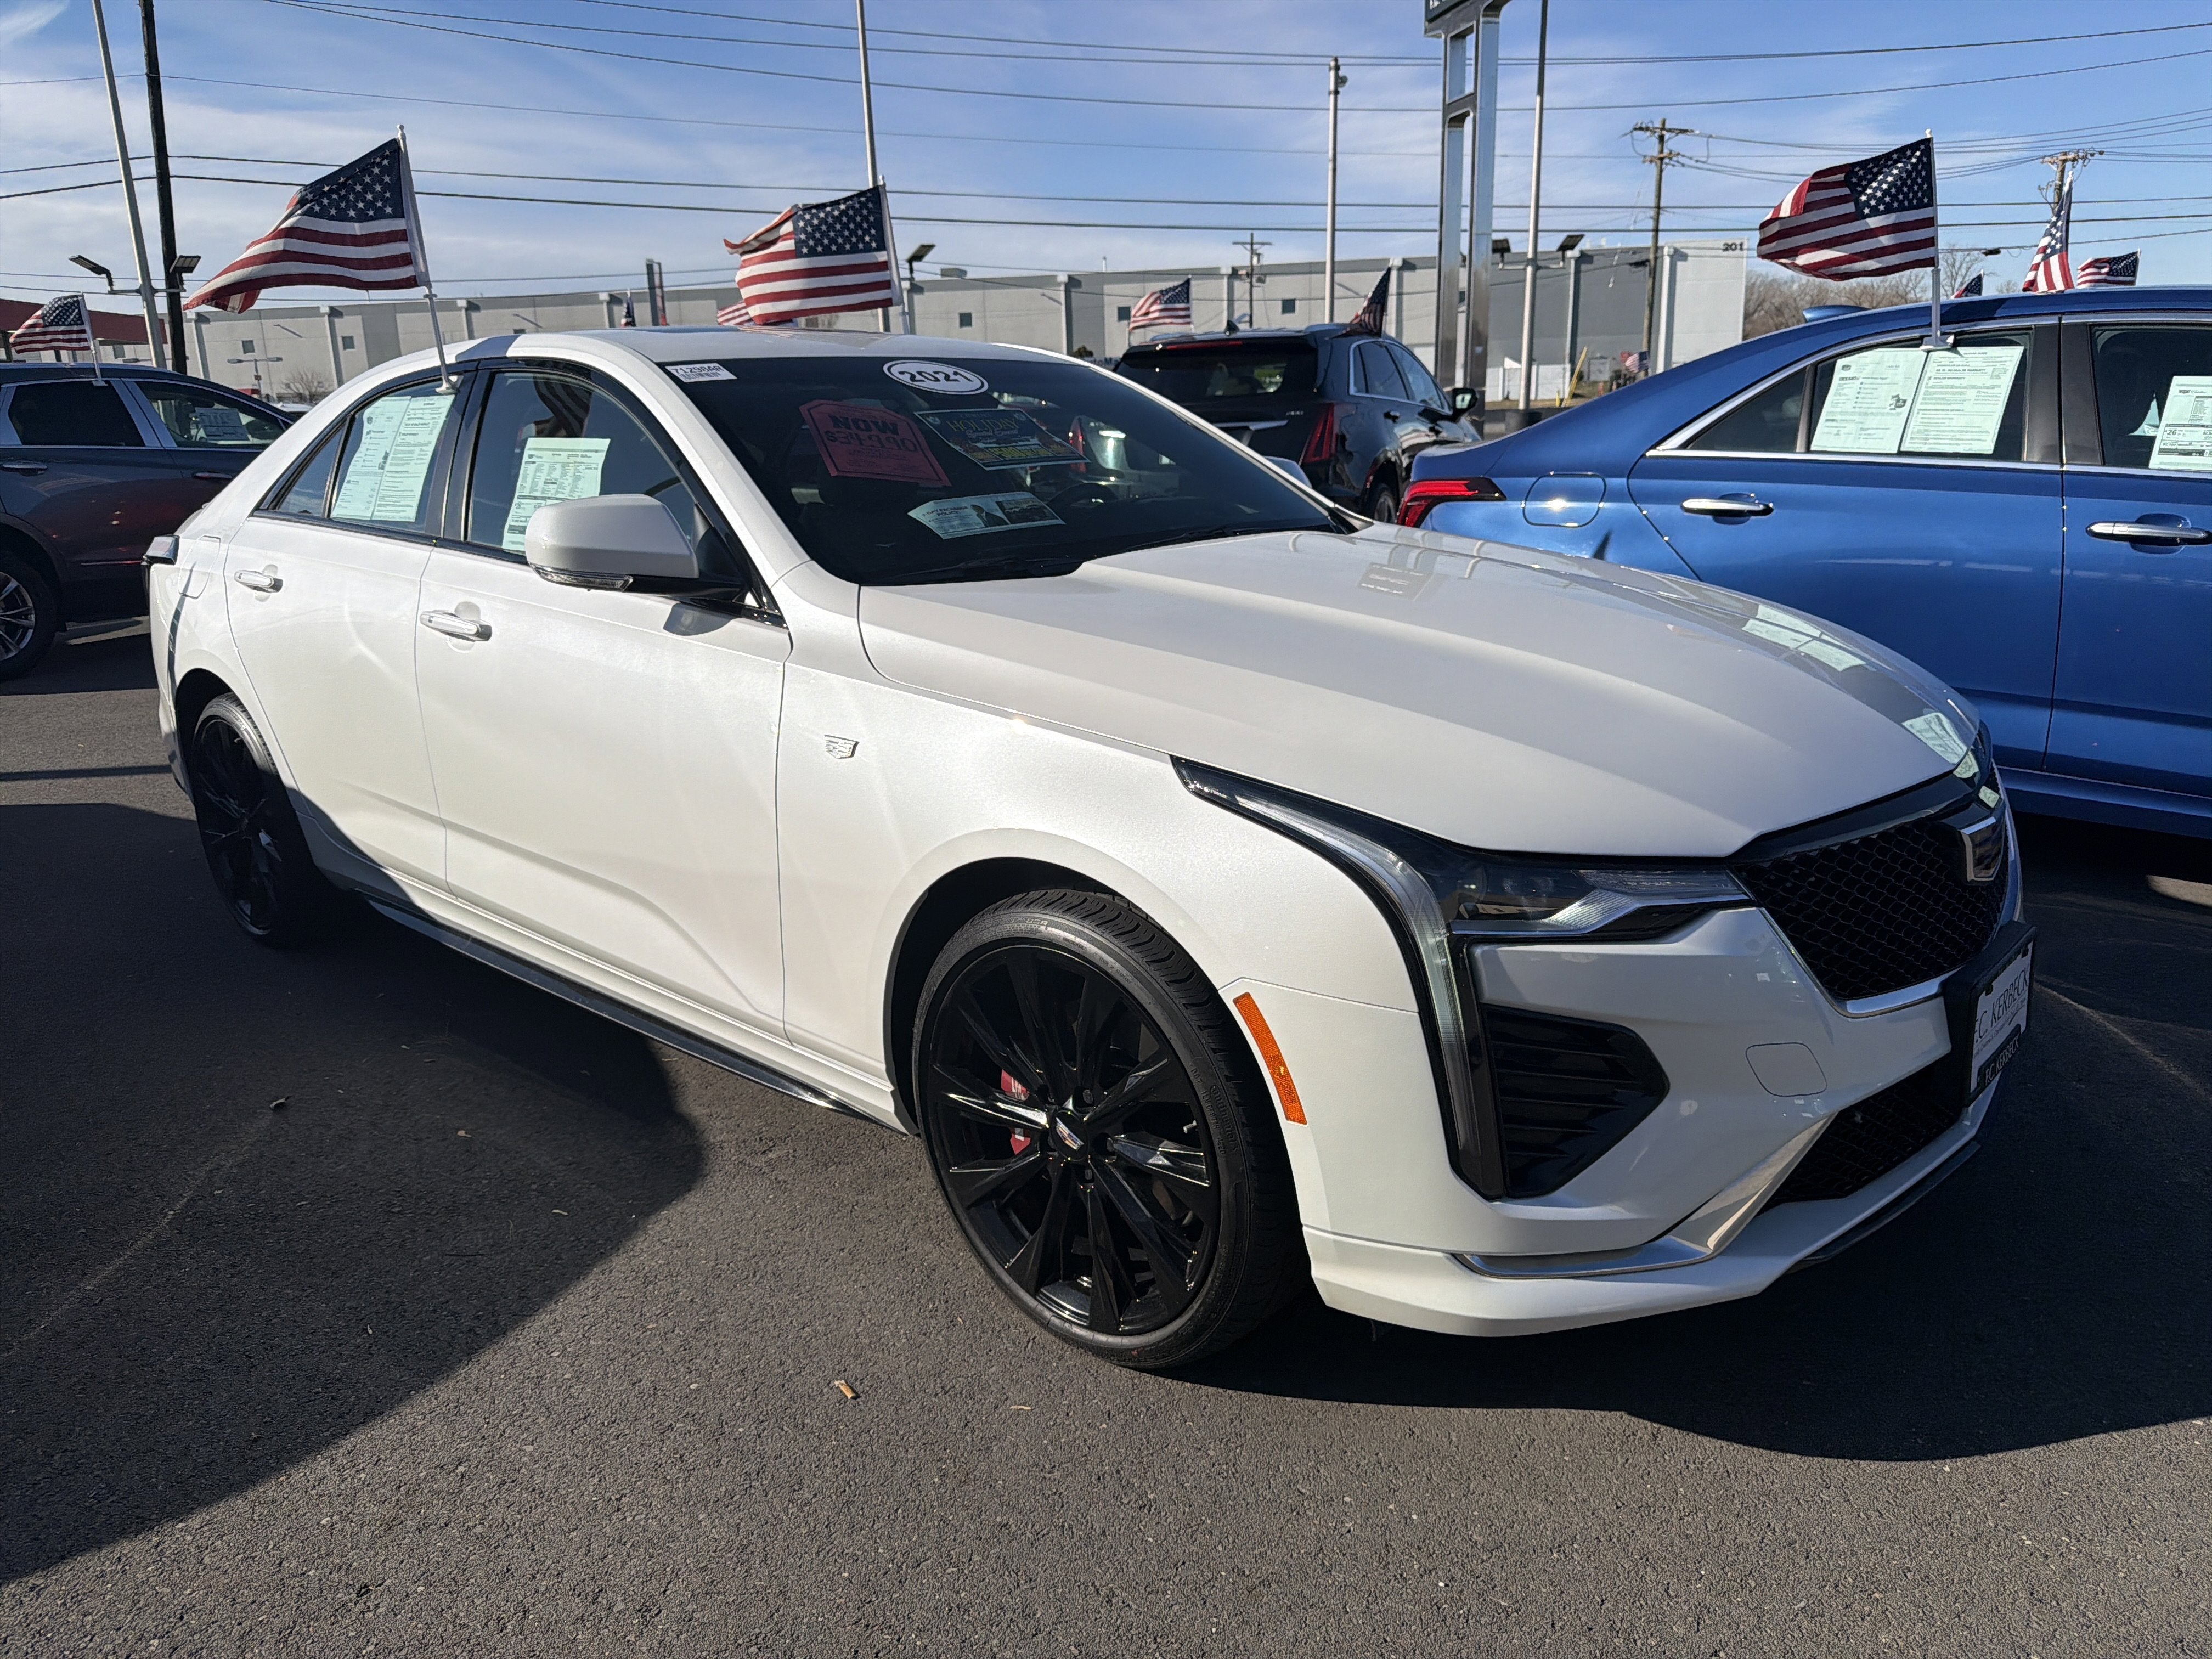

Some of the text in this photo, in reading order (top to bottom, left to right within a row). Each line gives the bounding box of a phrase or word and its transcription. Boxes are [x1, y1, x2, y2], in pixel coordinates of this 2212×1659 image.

[1722, 242, 1744, 252] 201
[671, 365, 724, 374] 71298AR
[898, 371, 973, 382] 2021
[828, 415, 900, 436] NOW
[946, 419, 1020, 432] HOLIDAY
[1991, 966, 2028, 1028] KERBECK
[1995, 1034, 2020, 1074] KERBECK
[1190, 1068, 1203, 1085] DOT
